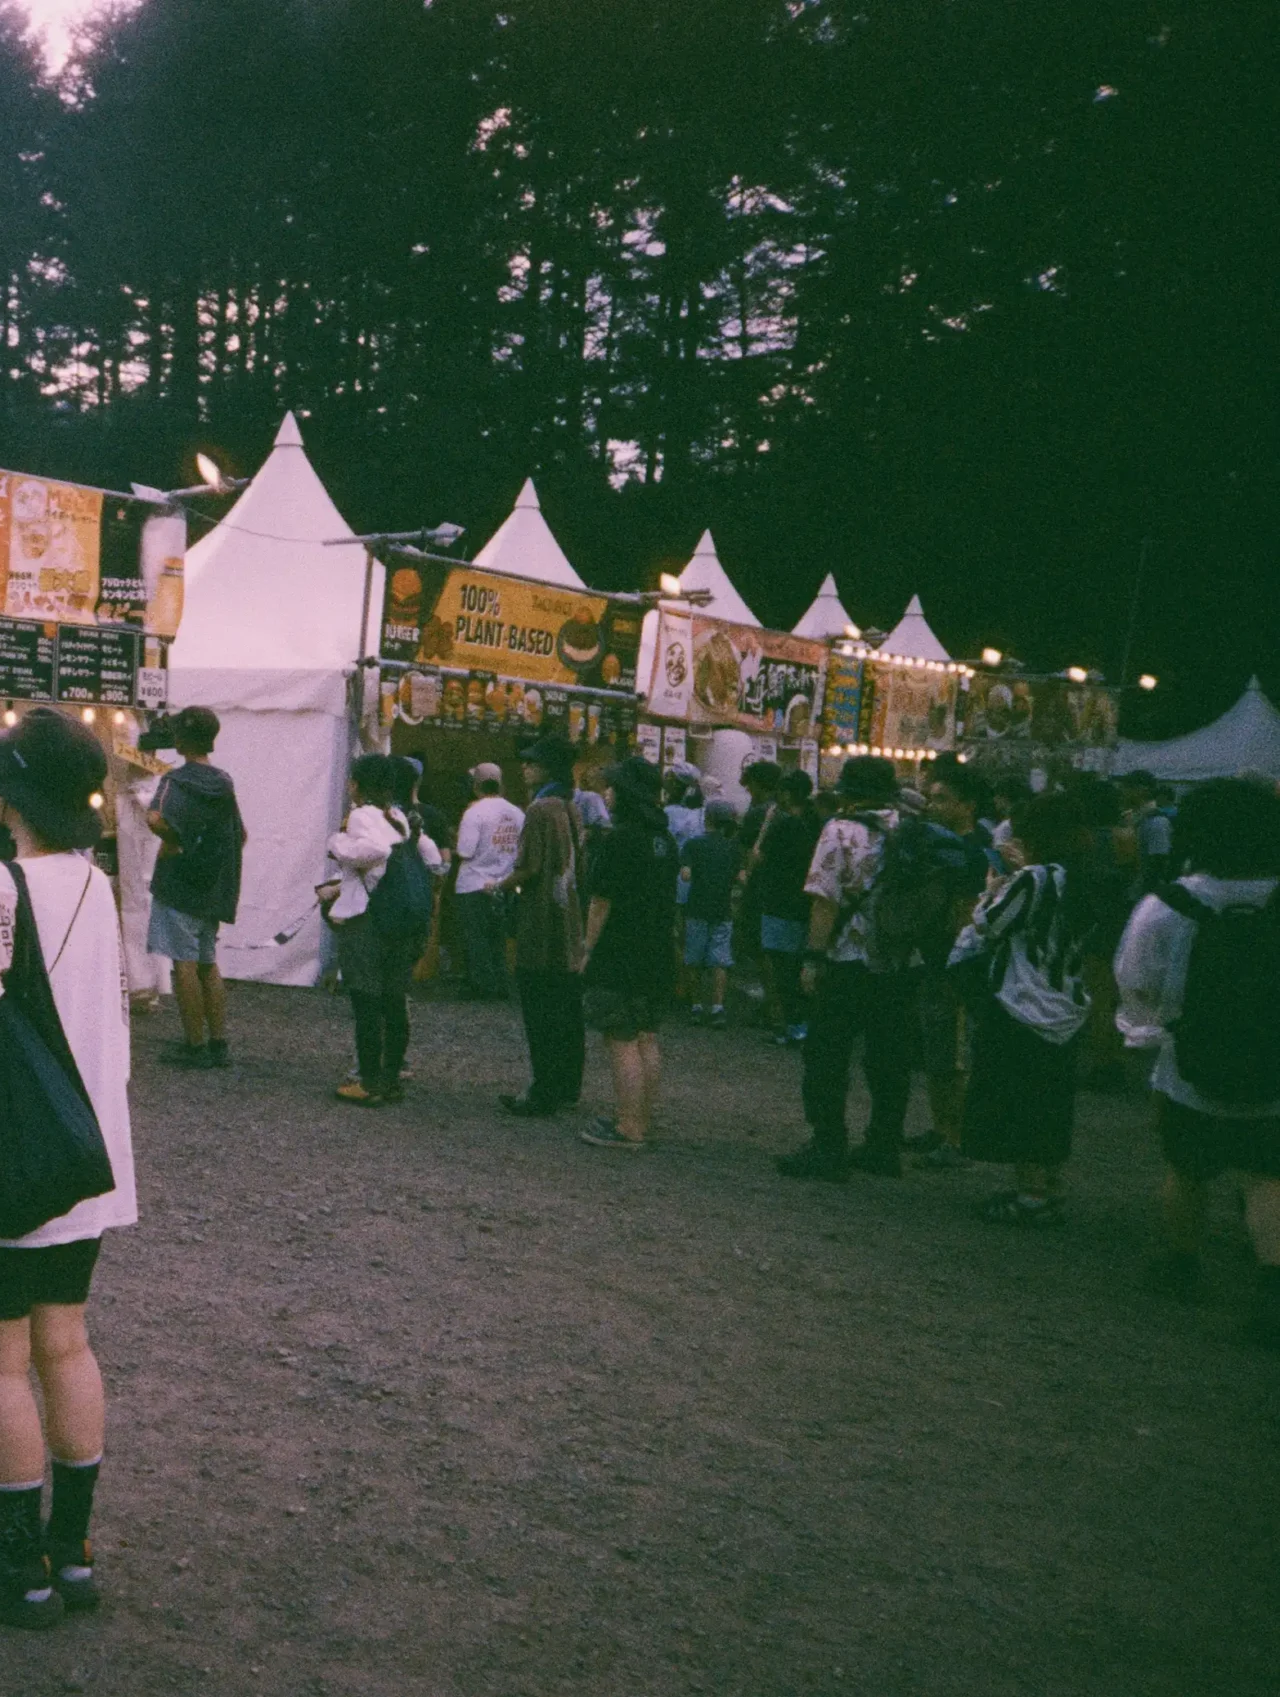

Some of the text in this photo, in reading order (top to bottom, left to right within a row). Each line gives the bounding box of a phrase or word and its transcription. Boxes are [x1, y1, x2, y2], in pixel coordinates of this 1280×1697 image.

[461, 584, 501, 617] 100%
[456, 615, 554, 657] PLANT BASED
